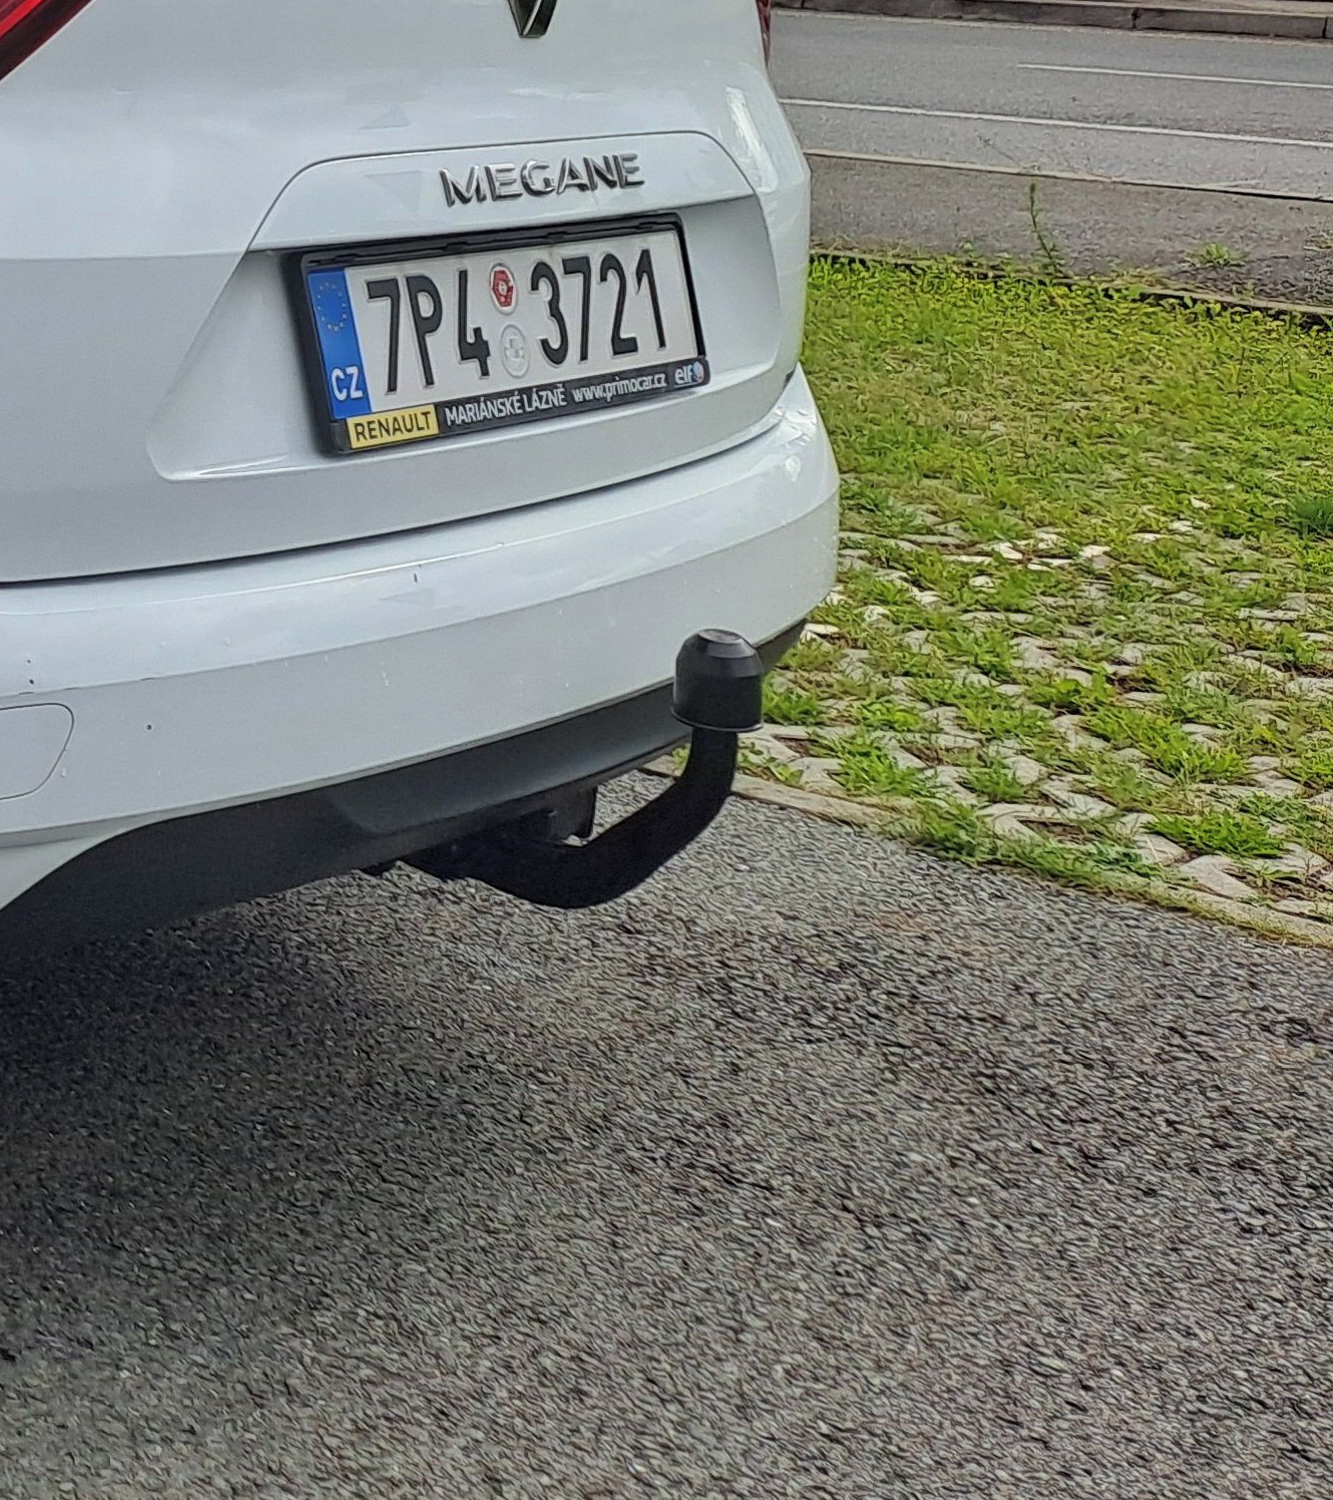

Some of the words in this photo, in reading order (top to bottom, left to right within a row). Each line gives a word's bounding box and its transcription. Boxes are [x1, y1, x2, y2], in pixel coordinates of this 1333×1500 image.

[440, 153, 645, 208] MEGANE
[367, 269, 491, 395] 7P4
[531, 249, 667, 365] 3721
[331, 366, 363, 401] CZ
[674, 365, 694, 385] elf
[445, 390, 524, 426] MARIÁNSKÉ
[524, 384, 568, 412] LÁZNĚ
[571, 373, 668, 403] www.primocar.cz
[355, 411, 432, 442] RENAULT
